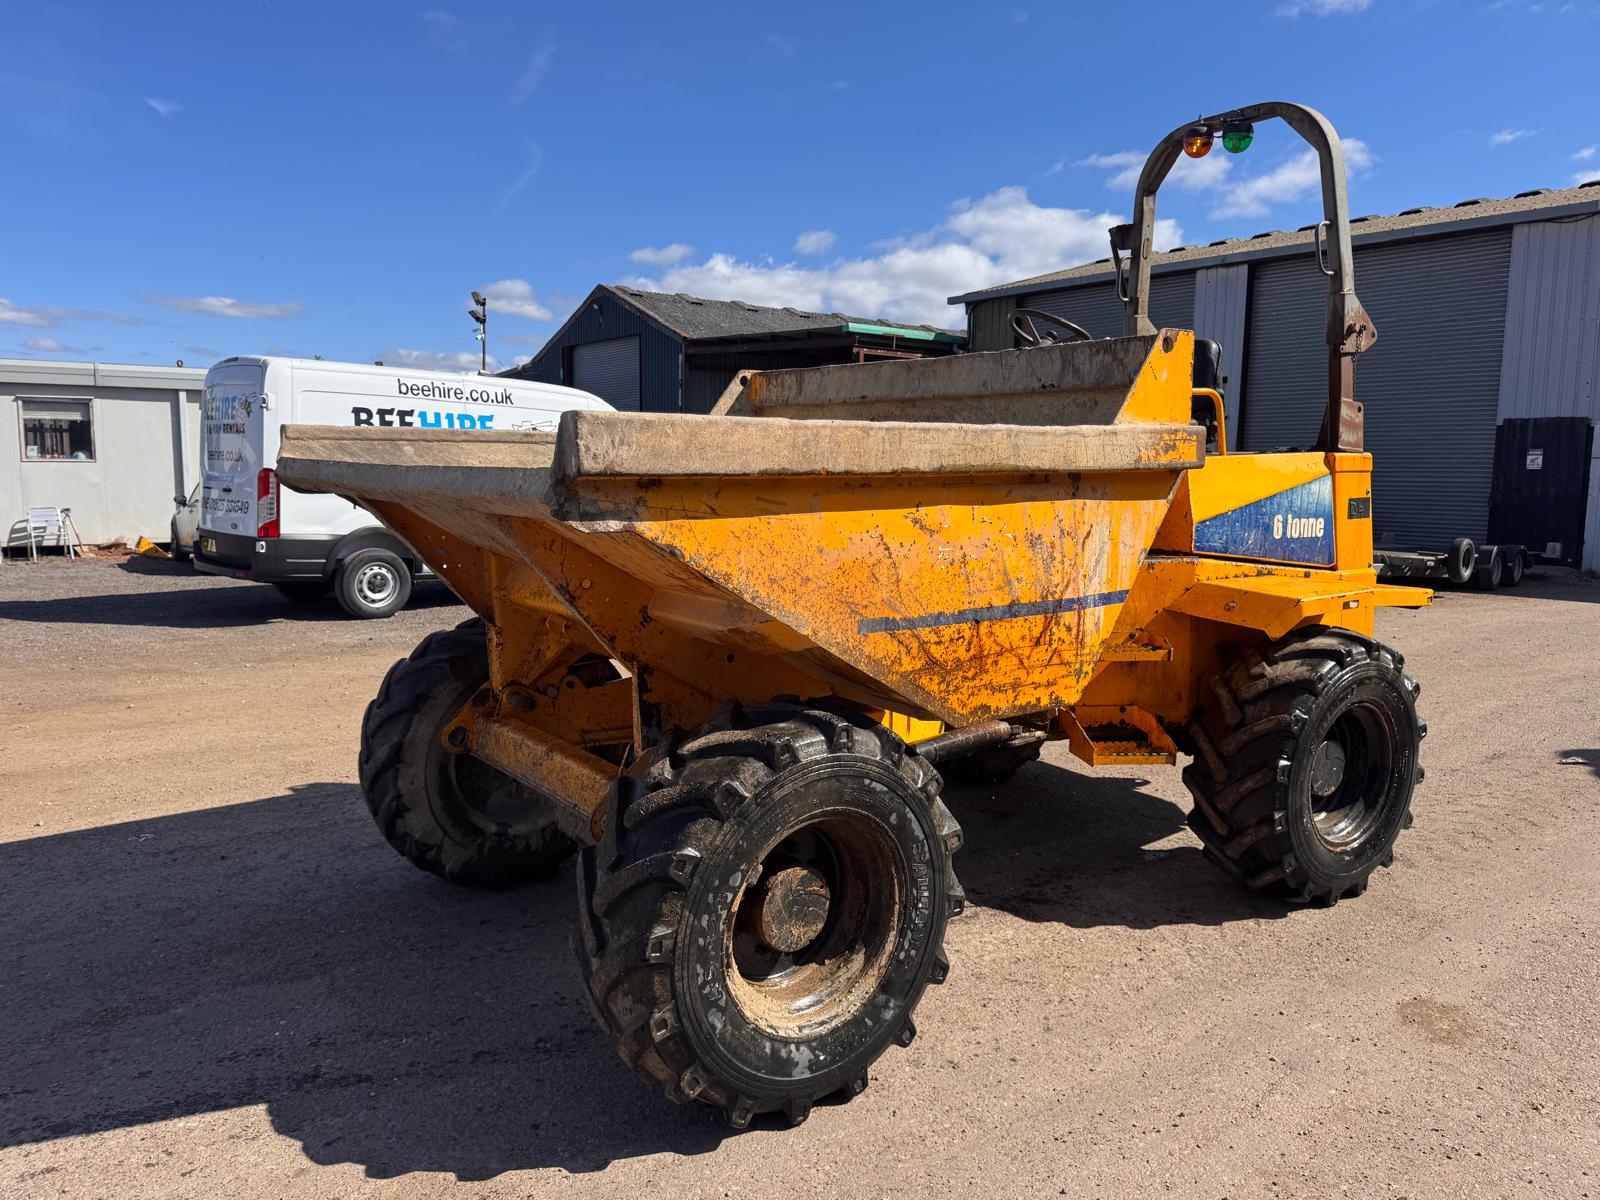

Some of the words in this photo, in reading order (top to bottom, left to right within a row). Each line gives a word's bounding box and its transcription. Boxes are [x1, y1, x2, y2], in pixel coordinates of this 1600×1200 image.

[397, 377, 514, 405] beehire.co.uk
[1273, 514, 1283, 540] 6
[1286, 512, 1325, 539] tonne
